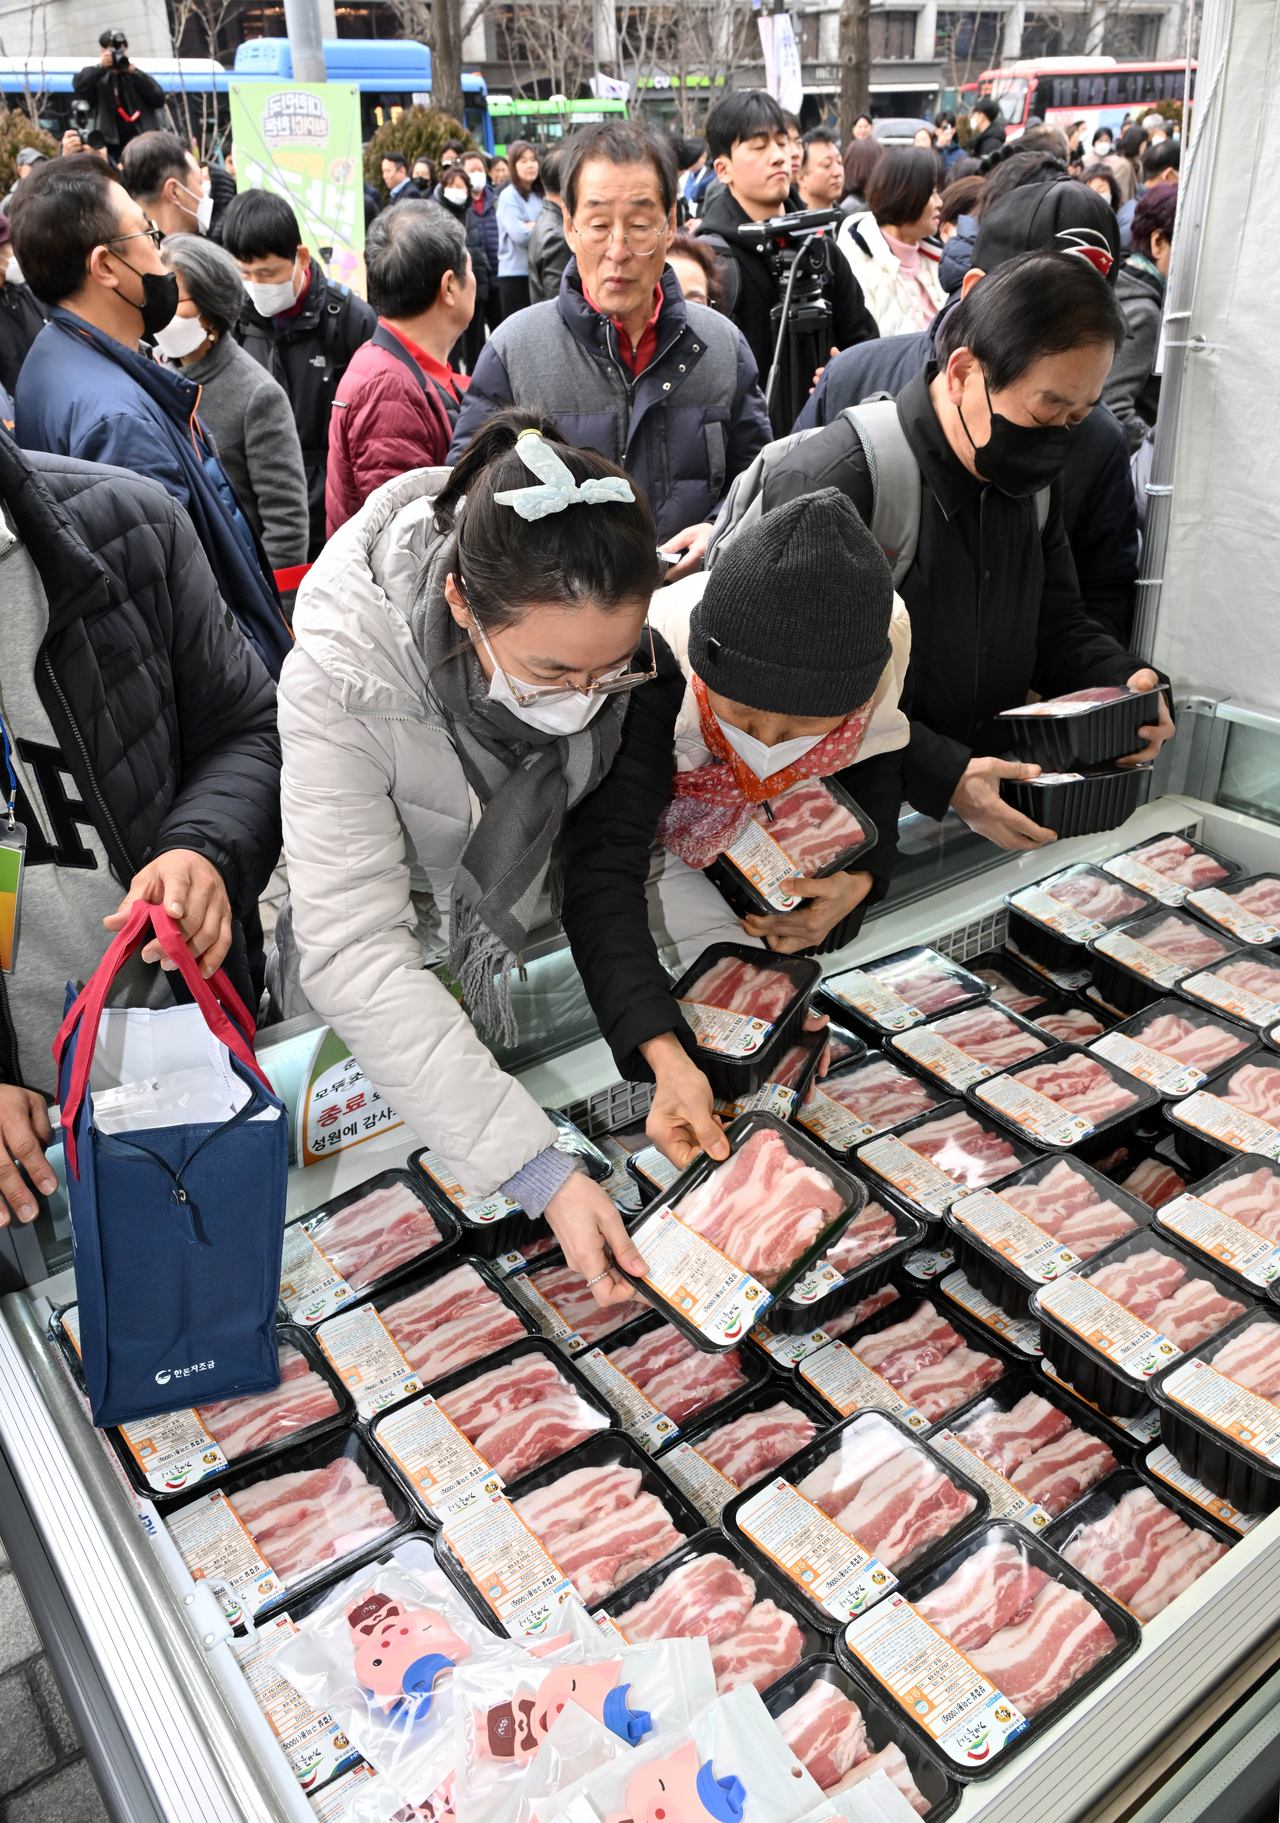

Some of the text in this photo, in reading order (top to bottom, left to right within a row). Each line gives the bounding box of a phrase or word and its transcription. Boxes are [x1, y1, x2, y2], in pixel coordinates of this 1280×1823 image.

[653, 76, 671, 88] CU
[313, 1072, 365, 1102] 모두 소
[317, 1092, 368, 1128] 종료
[311, 1106, 397, 1152] 성원에 감사
[322, 1277, 335, 1287] 삼겹살
[701, 1272, 738, 1313] 삼겹살 구이용(1000g)
[762, 1296, 771, 1306] NH
[173, 1359, 216, 1379] 한돈자조금
[363, 1367, 405, 1392] 삼겹살 구이용(1000g)
[156, 1437, 205, 1463] 삼겹살 구이용(1000g)
[439, 1465, 483, 1495] 삼겹살 구이용(1000g)
[243, 1564, 260, 1577] 삼겹살
[823, 1553, 864, 1589] 삼겹살 구이용(1000g)
[271, 1591, 282, 1599] NH
[508, 1574, 556, 1608] 삼겹살 구이용(1000g)
[939, 1684, 986, 1725] 삼겹살 구이용(1000g)
[279, 1722, 317, 1753] 구이용(1000g)
[1015, 1722, 1027, 1733] NH
[348, 1749, 360, 1760] NH
